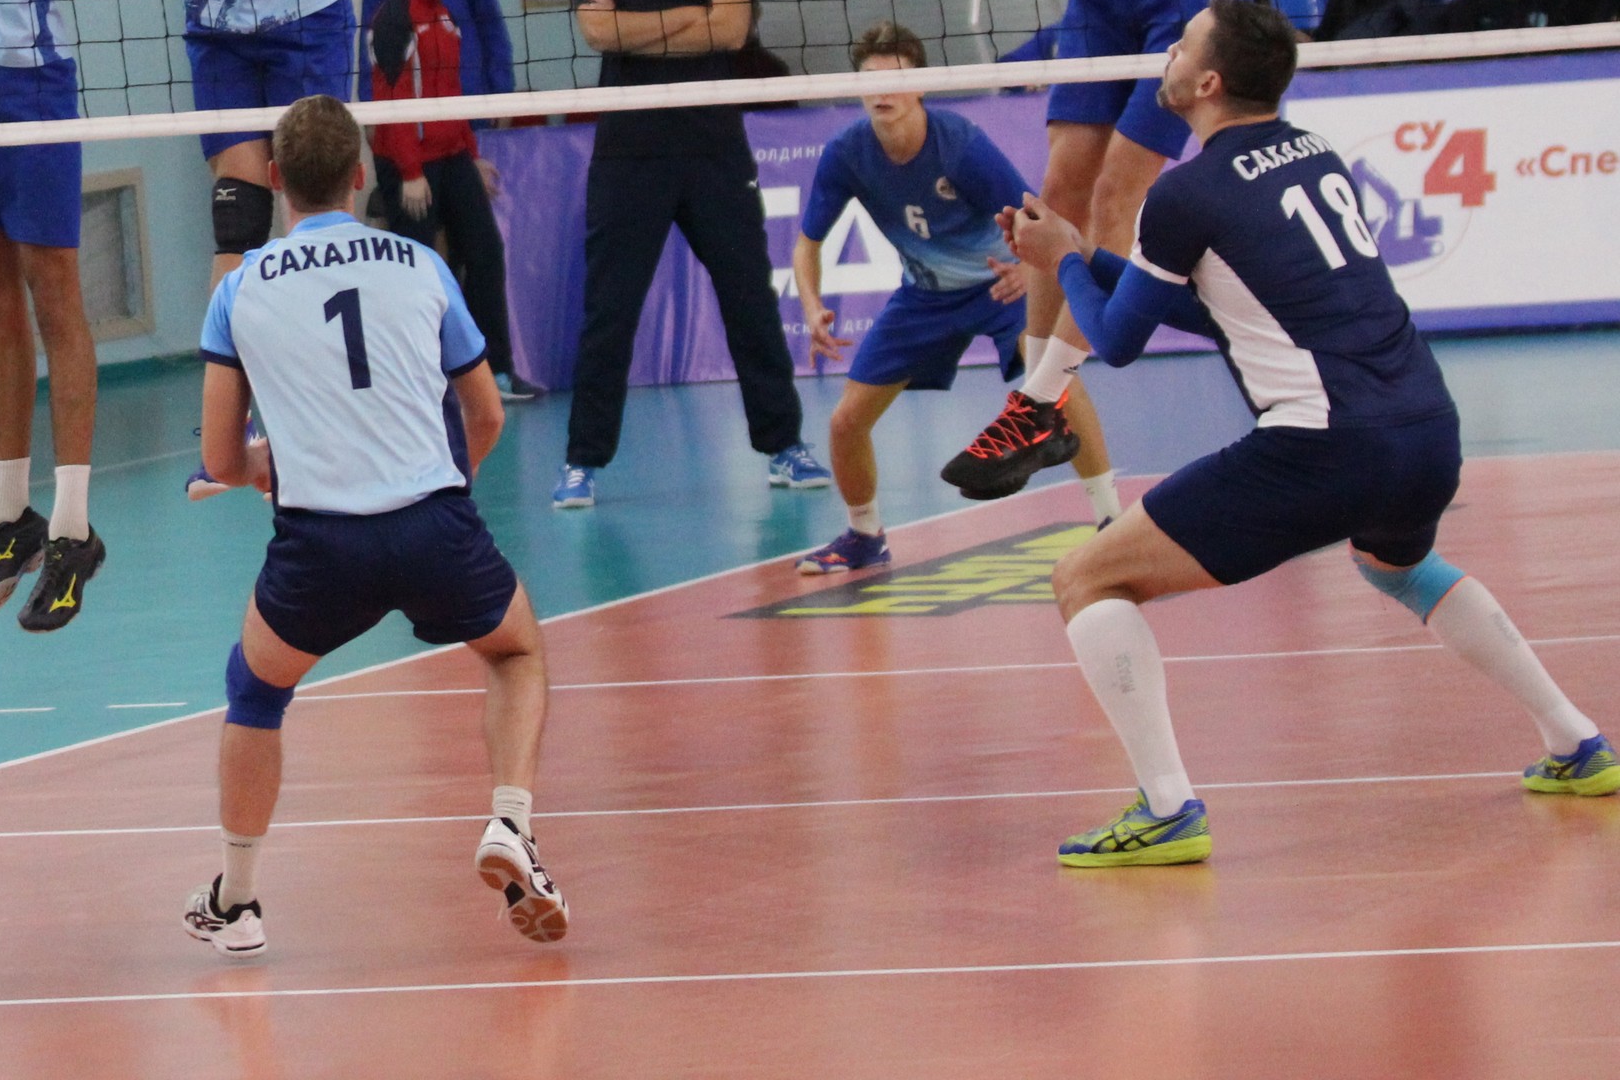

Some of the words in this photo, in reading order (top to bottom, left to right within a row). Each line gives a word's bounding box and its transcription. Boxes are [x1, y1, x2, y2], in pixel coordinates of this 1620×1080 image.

[755, 145, 826, 163] ОЛДИНГ
[1394, 120, 1446, 153] СУ
[1422, 126, 1497, 208] 4
[905, 204, 931, 239] 6
[1281, 171, 1379, 270] 18
[259, 237, 416, 281] САХАЛИН
[323, 287, 372, 390] 1
